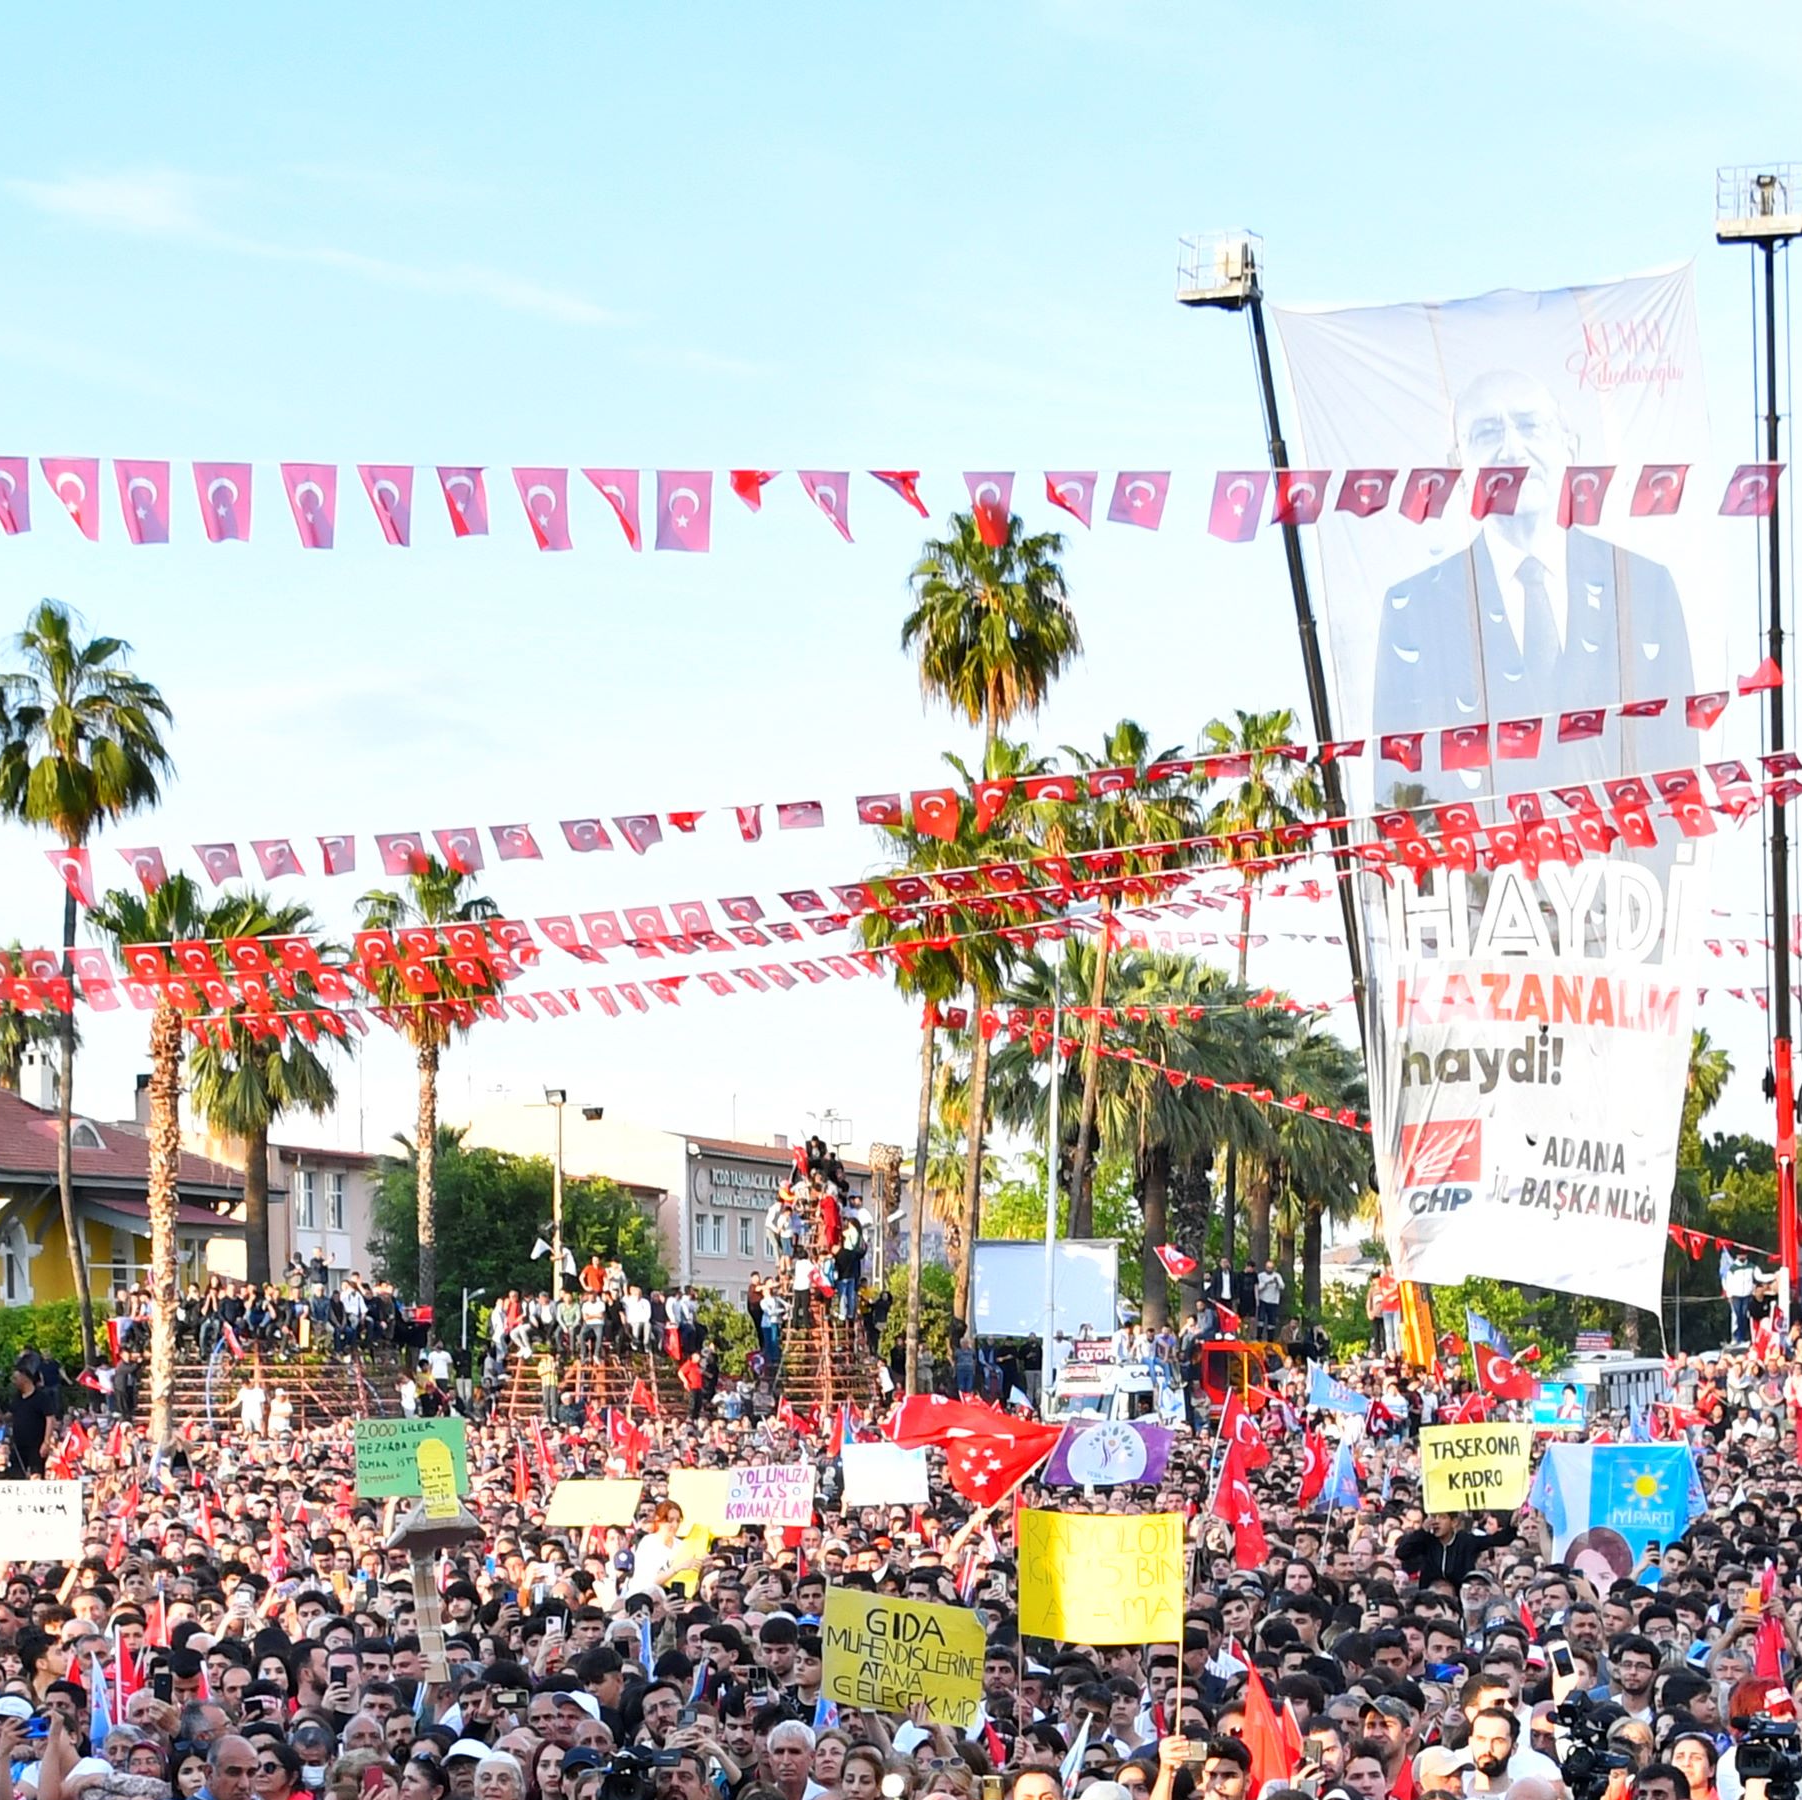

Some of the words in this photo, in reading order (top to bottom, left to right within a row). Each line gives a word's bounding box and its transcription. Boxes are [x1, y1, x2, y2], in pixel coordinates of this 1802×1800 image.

[1398, 843, 1697, 966] HAYDİ
[1397, 972, 1681, 1036] KAZANALIM
[1401, 1023, 1564, 1095] haydi!
[1542, 1135, 1627, 1175] ADANA
[1410, 1187, 1473, 1216] CHP
[1518, 1176, 1657, 1227] BAŞKANLIĞI
[1428, 1435, 1522, 1462] TAŞERONA
[737, 1467, 811, 1486] YOLUMUZA
[1457, 1468, 1504, 1492] KADRO
[725, 1500, 811, 1520] KOYAMAZLAR
[1137, 1555, 1183, 1588] BİN
[865, 1607, 947, 1647] GIDA
[1041, 1596, 1178, 1627] AMA
[859, 1660, 924, 1692] ATAMA
[832, 1675, 938, 1717] GELECEK
[941, 1697, 977, 1727] Mİ?
